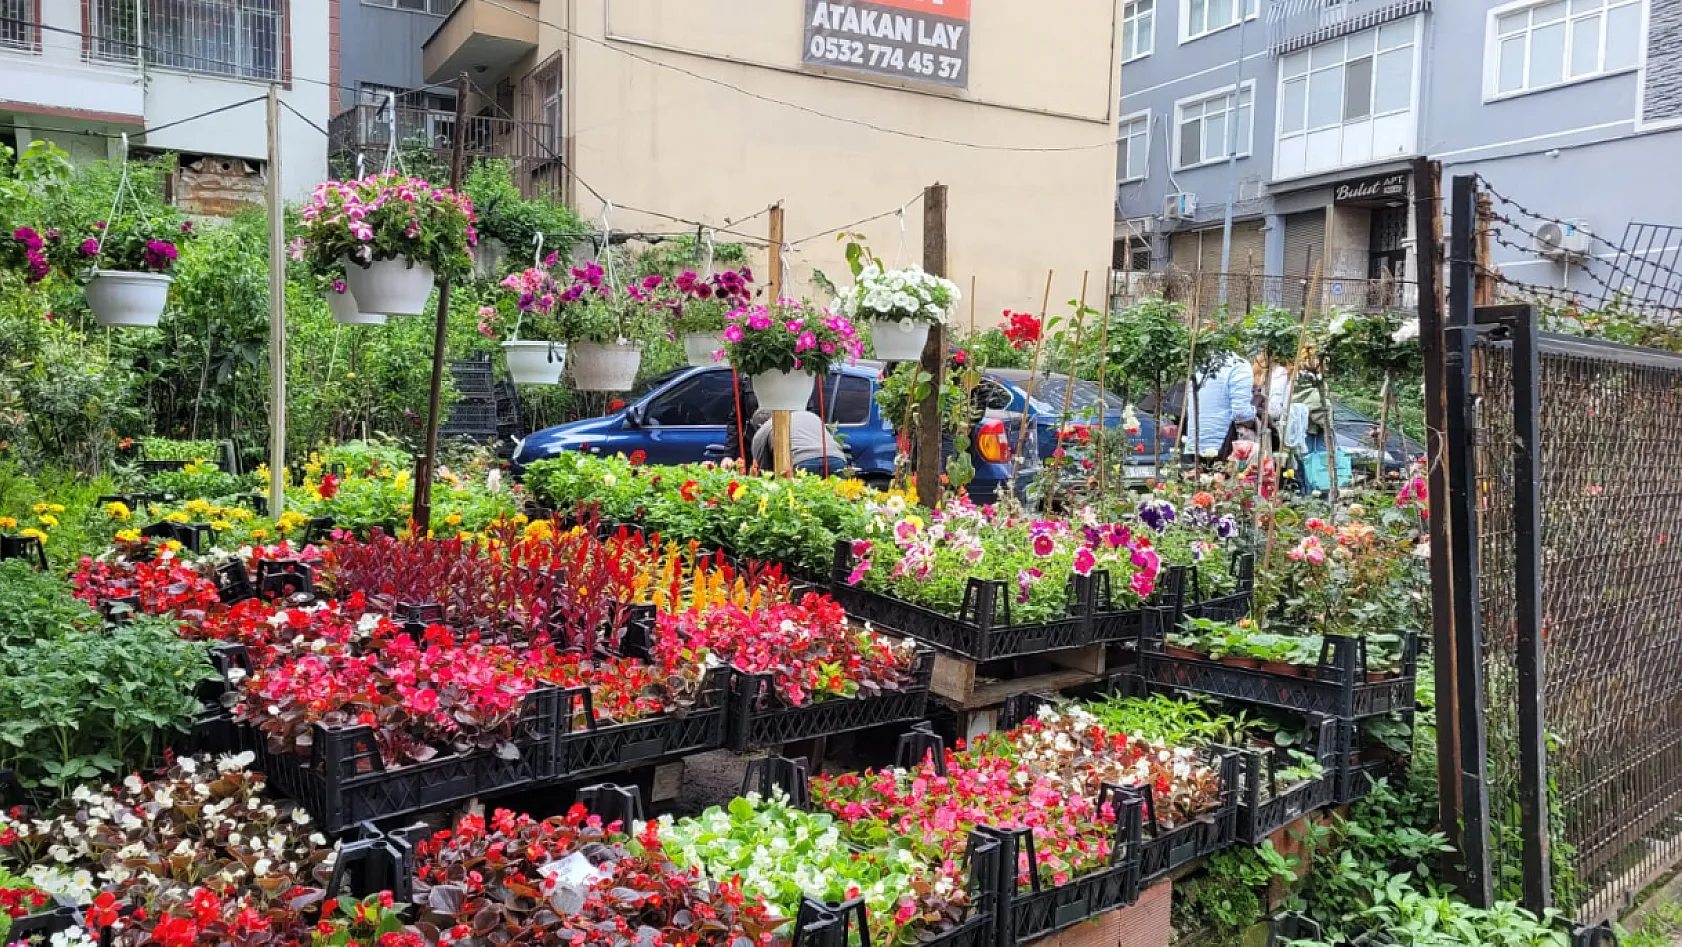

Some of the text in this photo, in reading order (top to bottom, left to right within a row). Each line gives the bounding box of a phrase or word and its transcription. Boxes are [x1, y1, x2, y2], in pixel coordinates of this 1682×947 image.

[812, 2, 964, 51] ATAKAN LAY
[810, 35, 962, 80] 0532 774 45 37
[1336, 180, 1381, 200] Bulut
